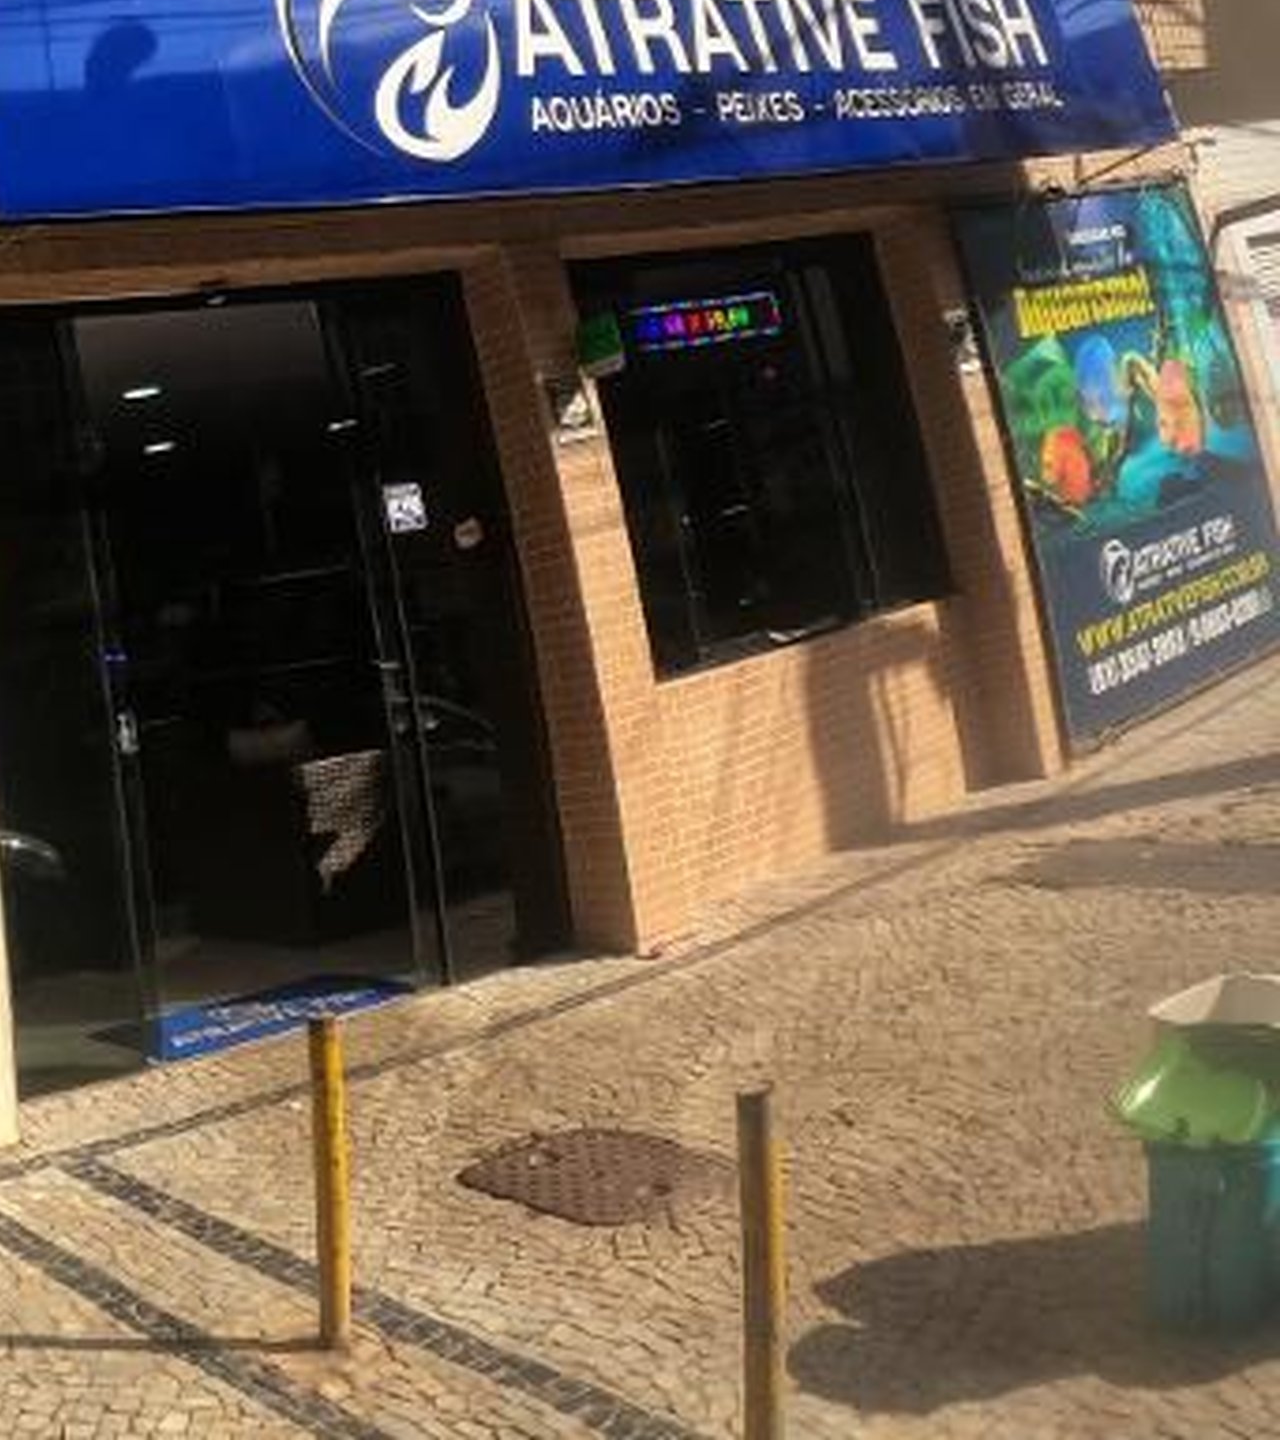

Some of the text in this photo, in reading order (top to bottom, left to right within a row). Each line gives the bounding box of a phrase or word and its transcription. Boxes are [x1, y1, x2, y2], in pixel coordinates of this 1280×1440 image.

[531, 87, 682, 133] AQUÁRIOS
[717, 90, 807, 122] PEIXES
[1002, 79, 1064, 110] GERAL
